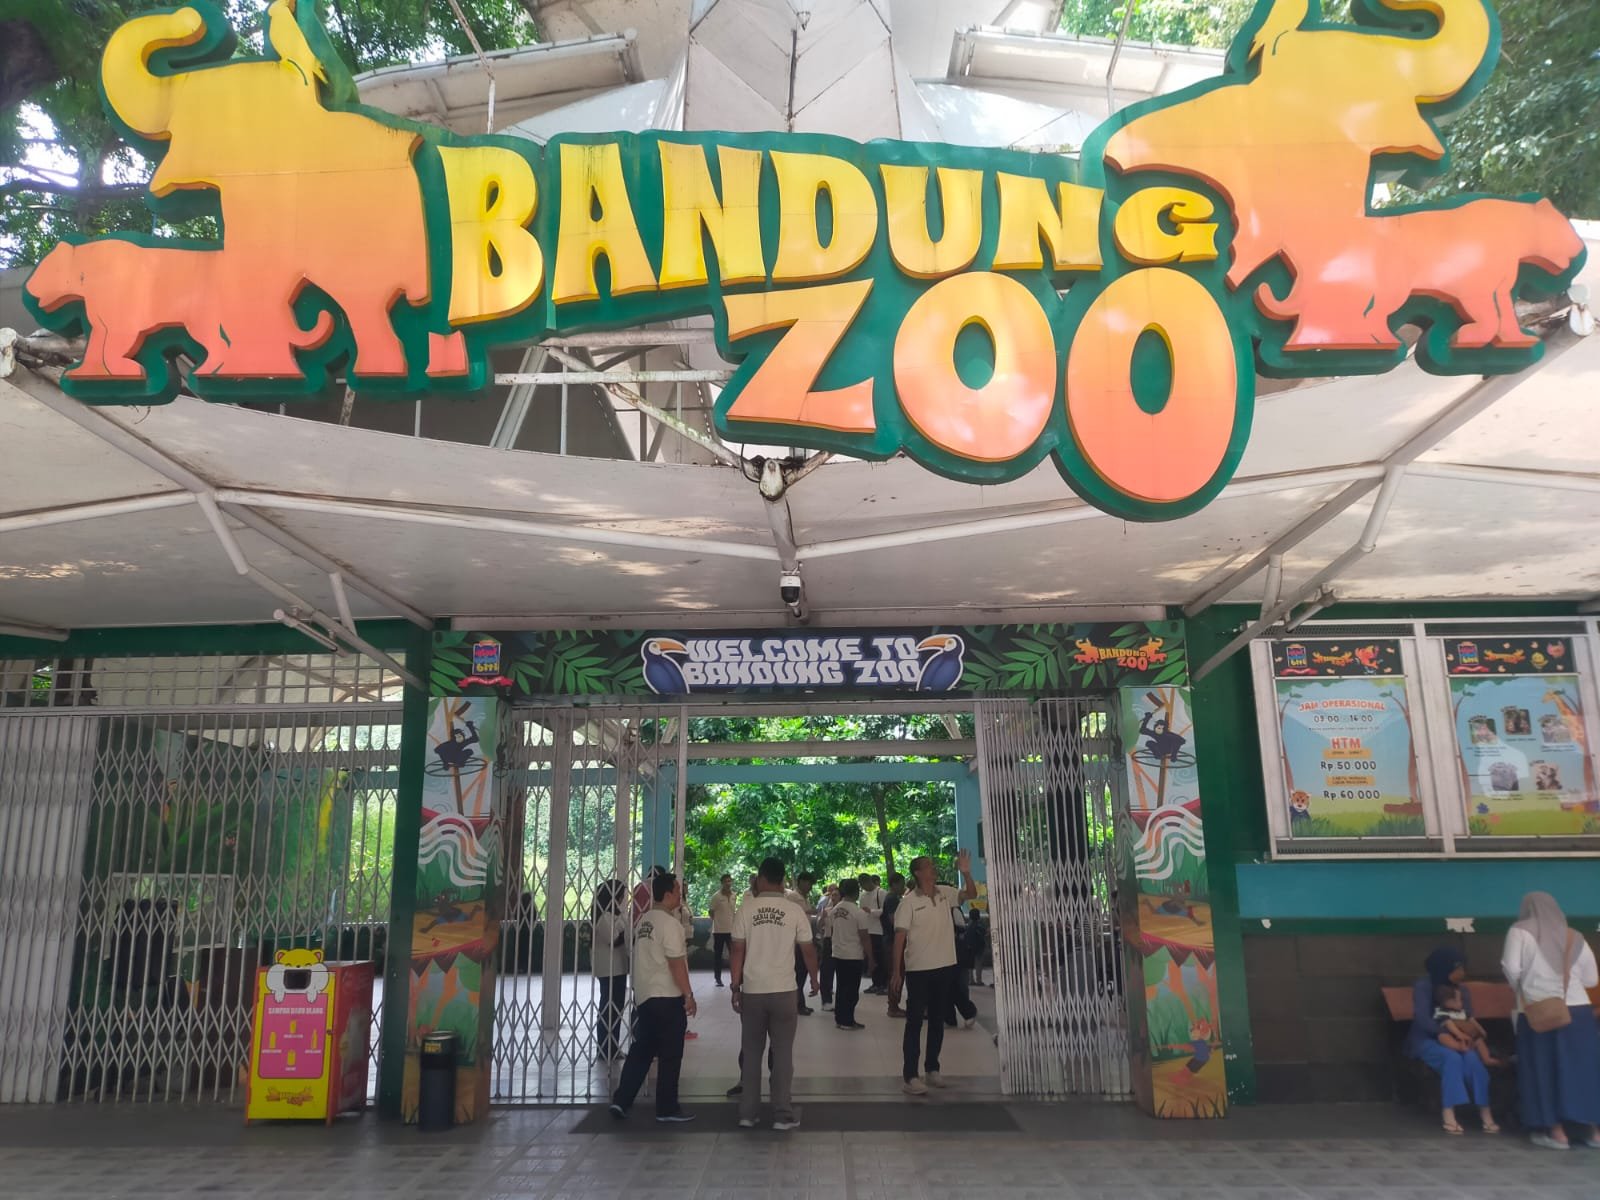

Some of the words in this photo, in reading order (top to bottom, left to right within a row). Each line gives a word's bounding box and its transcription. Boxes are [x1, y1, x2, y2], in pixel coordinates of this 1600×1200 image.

[438, 140, 1219, 326] BANDUNG
[720, 268, 1238, 504] ZOO
[687, 638, 863, 661] WELCOME
[872, 638, 919, 659] TO
[1098, 648, 1147, 660] BANDUNG
[682, 660, 844, 685] BANDUNG
[854, 659, 920, 683] ZOO
[1117, 656, 1148, 671] ZOO
[1299, 702, 1318, 711] JAM
[1322, 700, 1385, 710] OPERASIONAL
[1331, 737, 1361, 749] HTM
